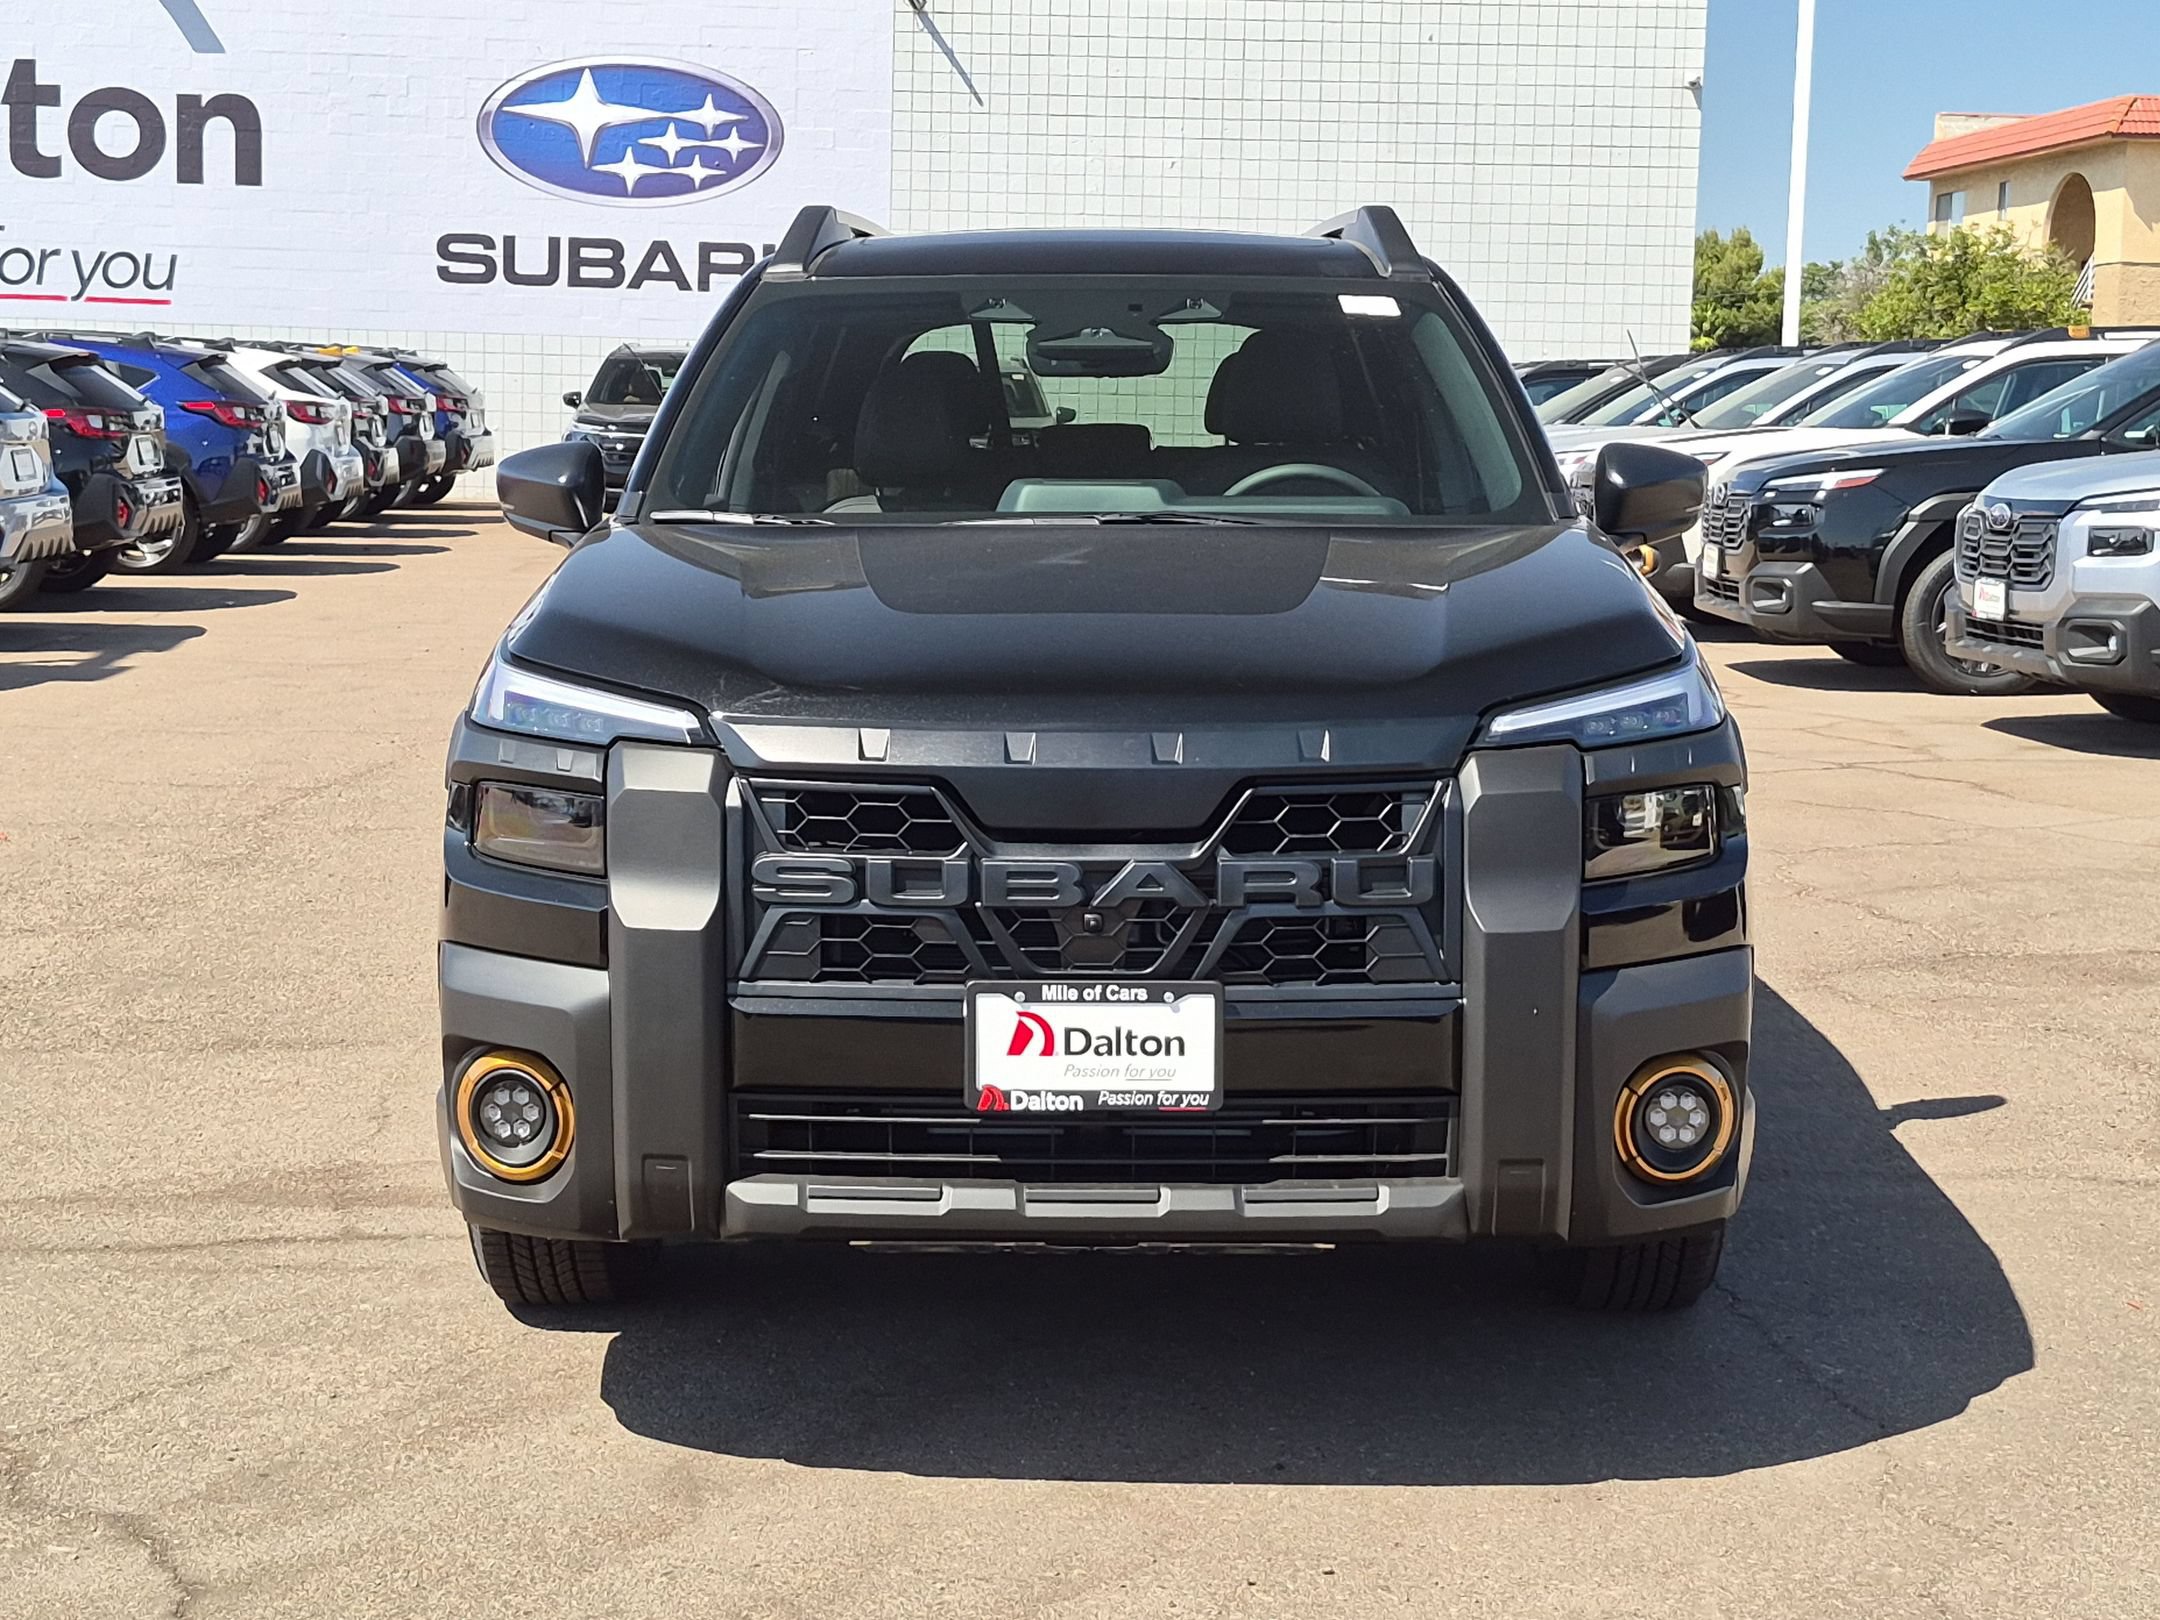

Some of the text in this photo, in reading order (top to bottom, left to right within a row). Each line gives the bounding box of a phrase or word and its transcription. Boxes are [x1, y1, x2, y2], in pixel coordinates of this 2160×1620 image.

[0, 225, 178, 301] or you
[436, 233, 776, 292] SUBAR
[751, 855, 1435, 907] SUBARU
[1041, 984, 1149, 1001] Mile of Cars
[1063, 1026, 1186, 1057] Dalton
[1063, 1063, 1176, 1080] Passion for you
[1010, 1090, 1084, 1111] Dalton
[1097, 1090, 1210, 1109] Passion for you
